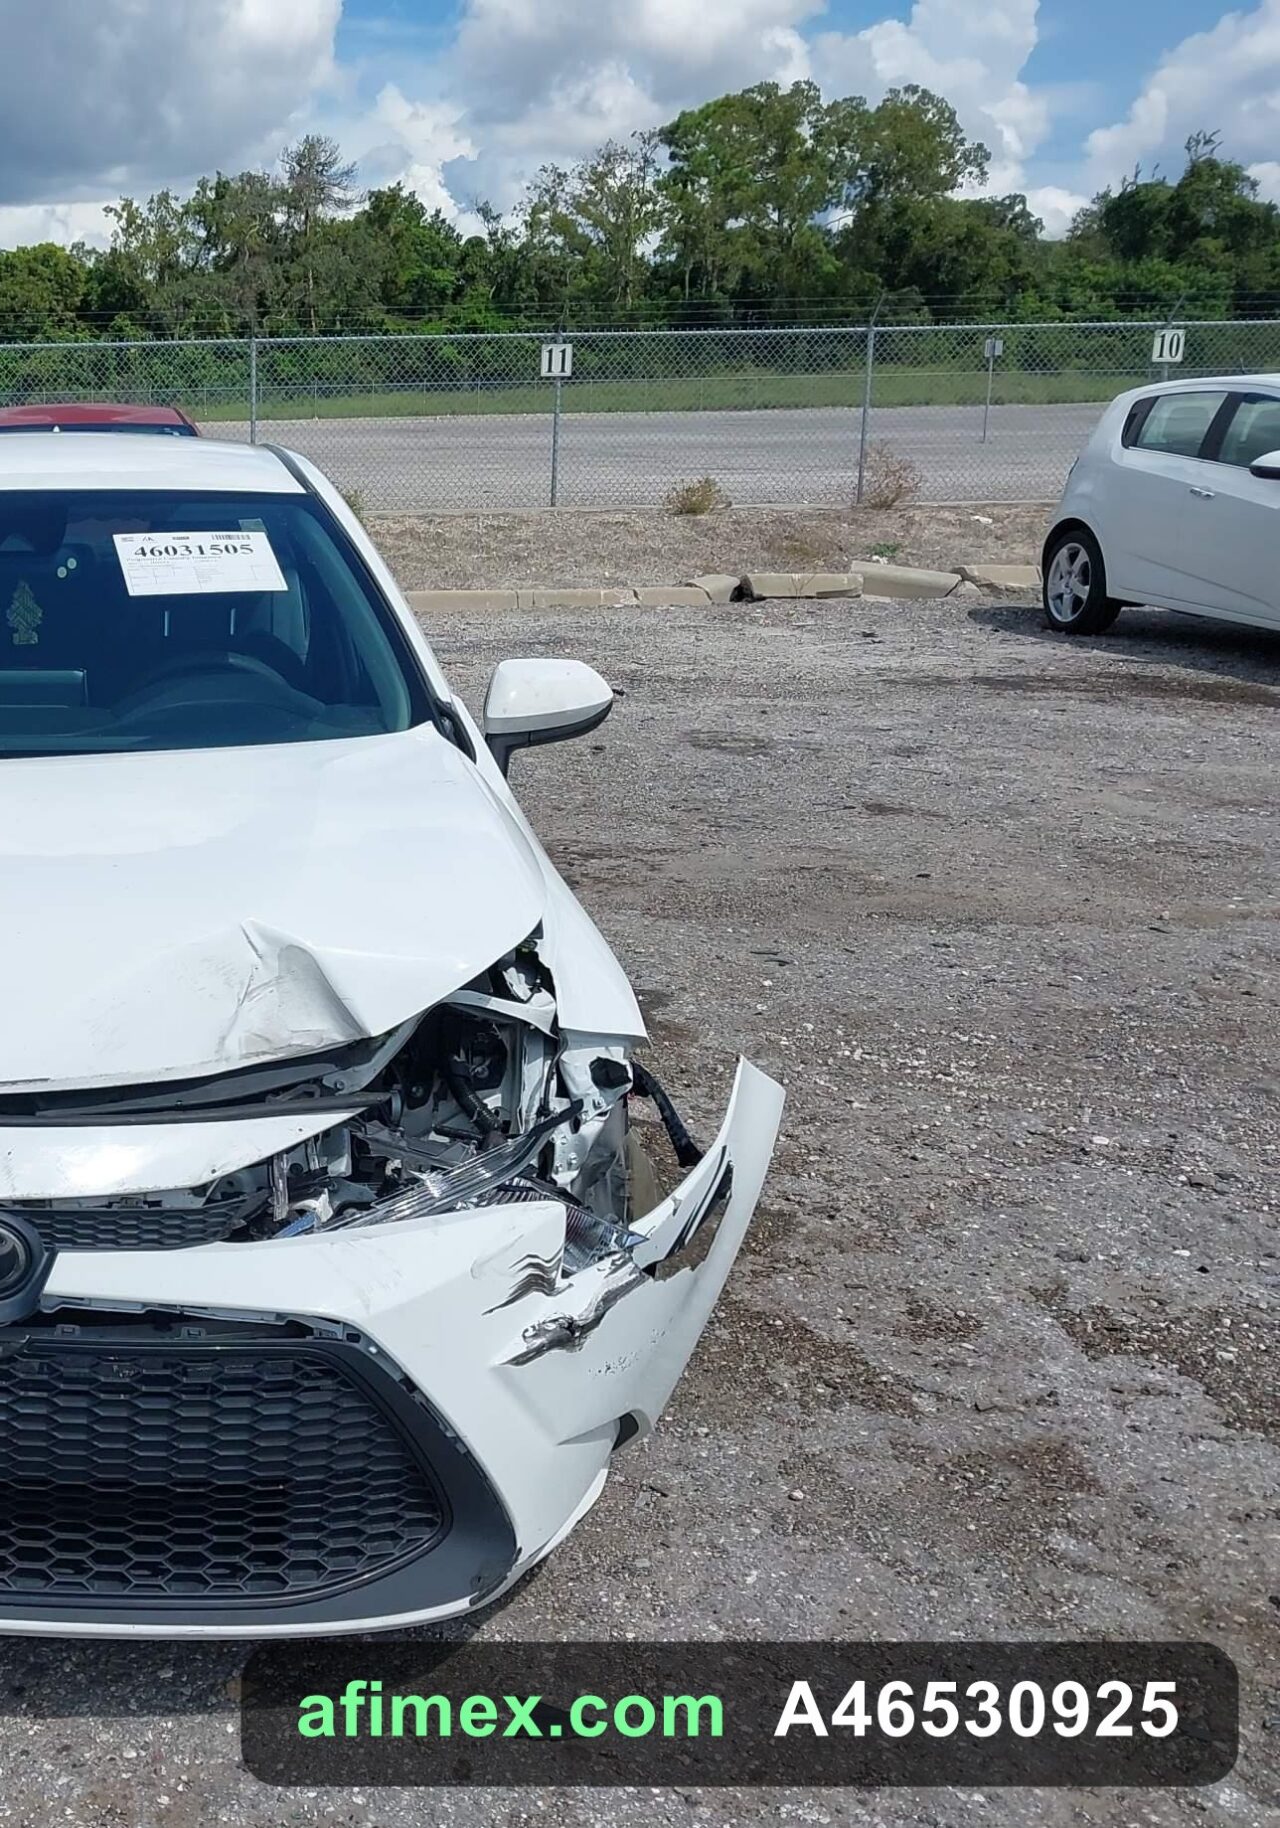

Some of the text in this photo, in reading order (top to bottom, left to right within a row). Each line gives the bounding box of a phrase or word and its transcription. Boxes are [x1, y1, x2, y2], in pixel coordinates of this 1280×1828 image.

[1156, 333, 1180, 359] 10
[545, 347, 568, 373] 11
[134, 543, 254, 557] 46031505
